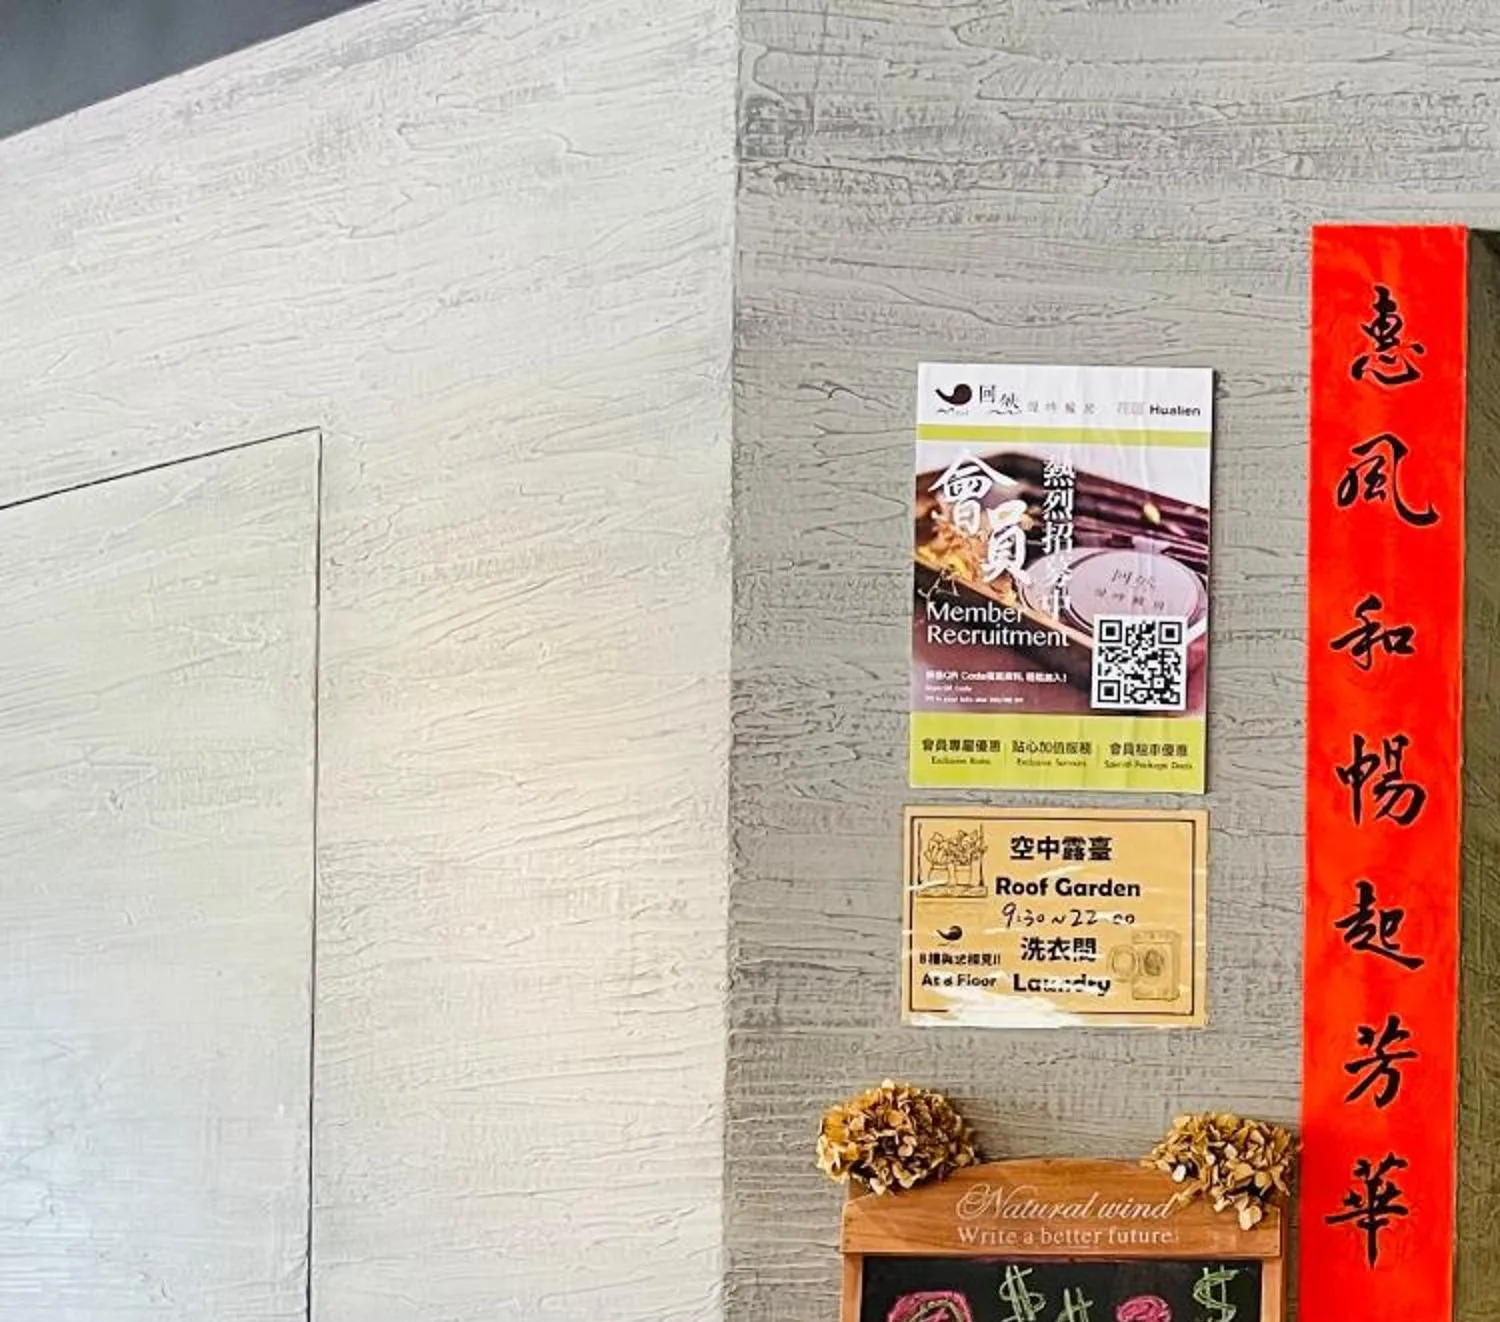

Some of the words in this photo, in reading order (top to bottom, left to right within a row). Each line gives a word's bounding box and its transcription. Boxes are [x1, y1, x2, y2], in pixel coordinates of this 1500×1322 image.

[1149, 404, 1201, 417] Hualien
[926, 600, 1026, 624] Member
[926, 624, 1070, 648] Recruitment
[995, 876, 1050, 897] Roof
[1054, 876, 1141, 898] Garden
[1012, 973, 1112, 997] Ladry
[955, 1182, 1100, 1221] Natural
[1097, 1195, 1177, 1220] wind
[957, 1226, 1018, 1244] Write
[1022, 1229, 1034, 1244] a
[1040, 1226, 1102, 1245] better
